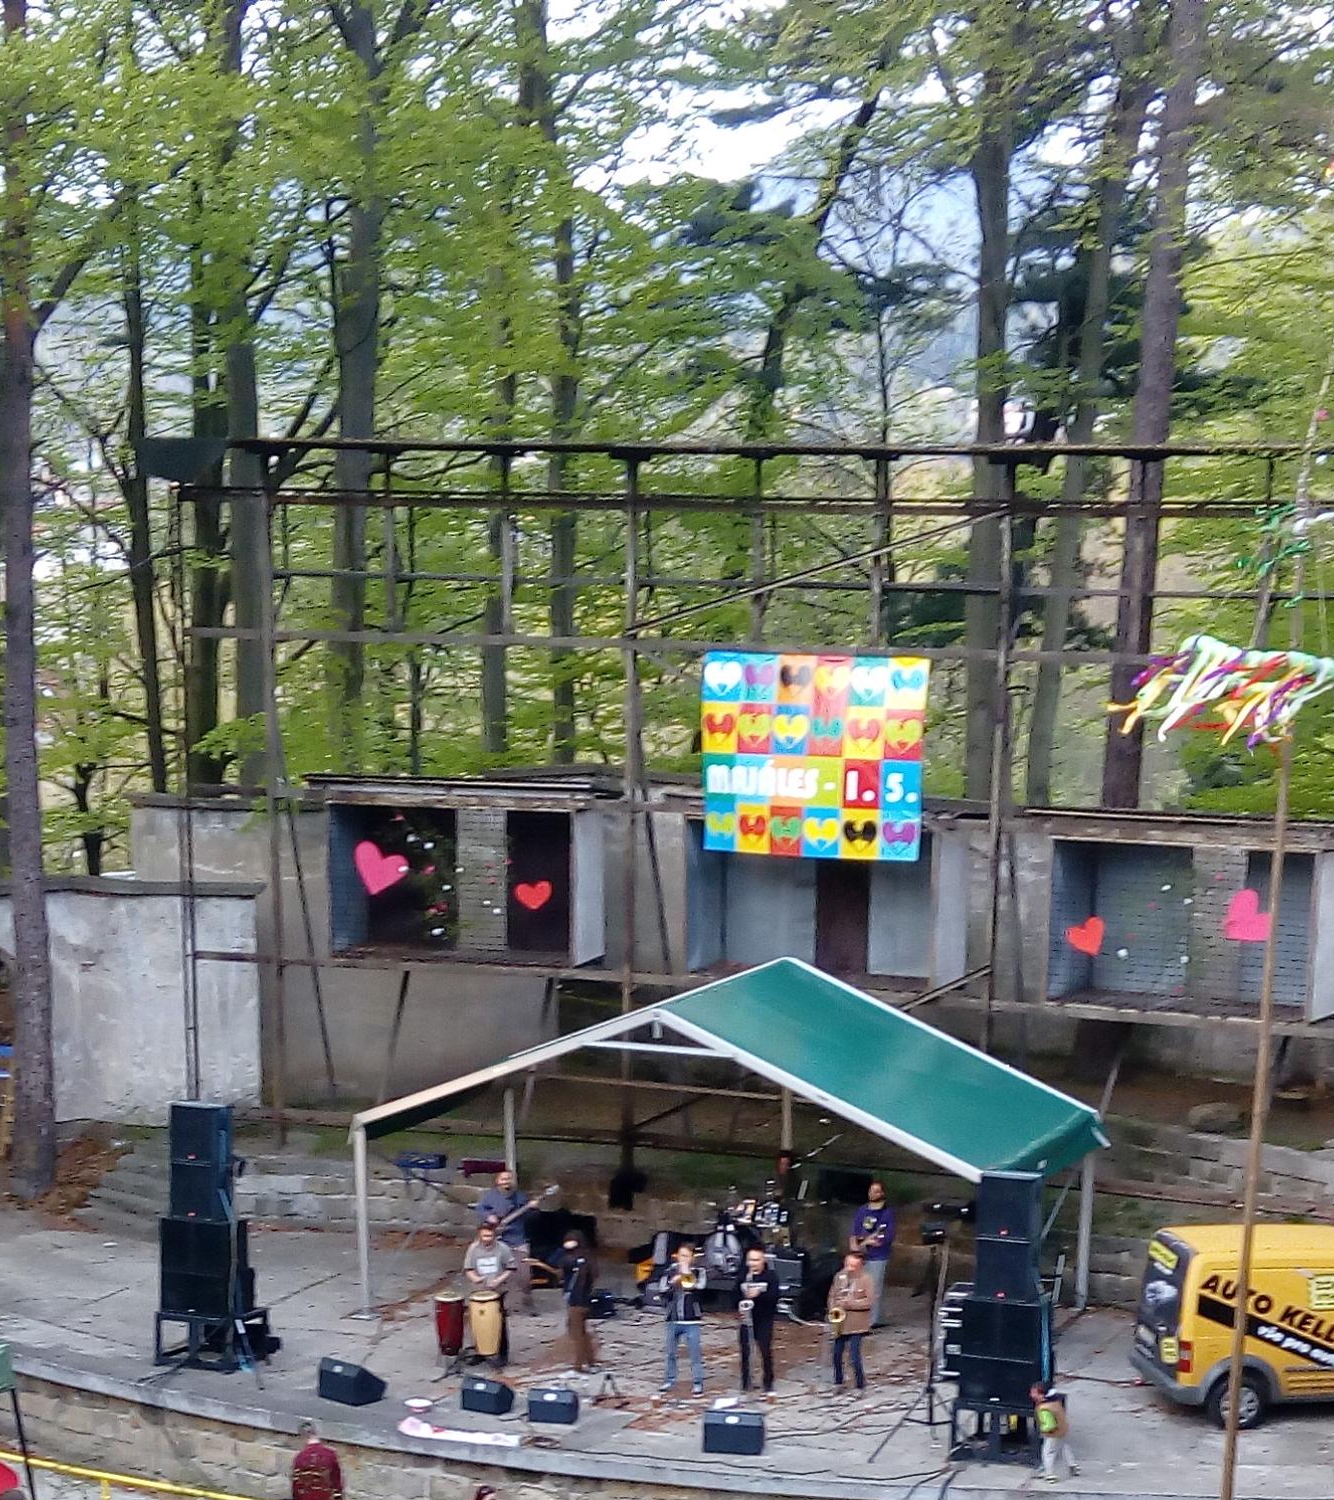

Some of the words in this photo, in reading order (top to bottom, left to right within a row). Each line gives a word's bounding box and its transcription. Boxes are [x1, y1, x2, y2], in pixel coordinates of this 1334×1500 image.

[706, 758, 820, 799] MAJÁLES
[846, 769, 876, 802] 1.
[885, 772, 919, 803] 5.
